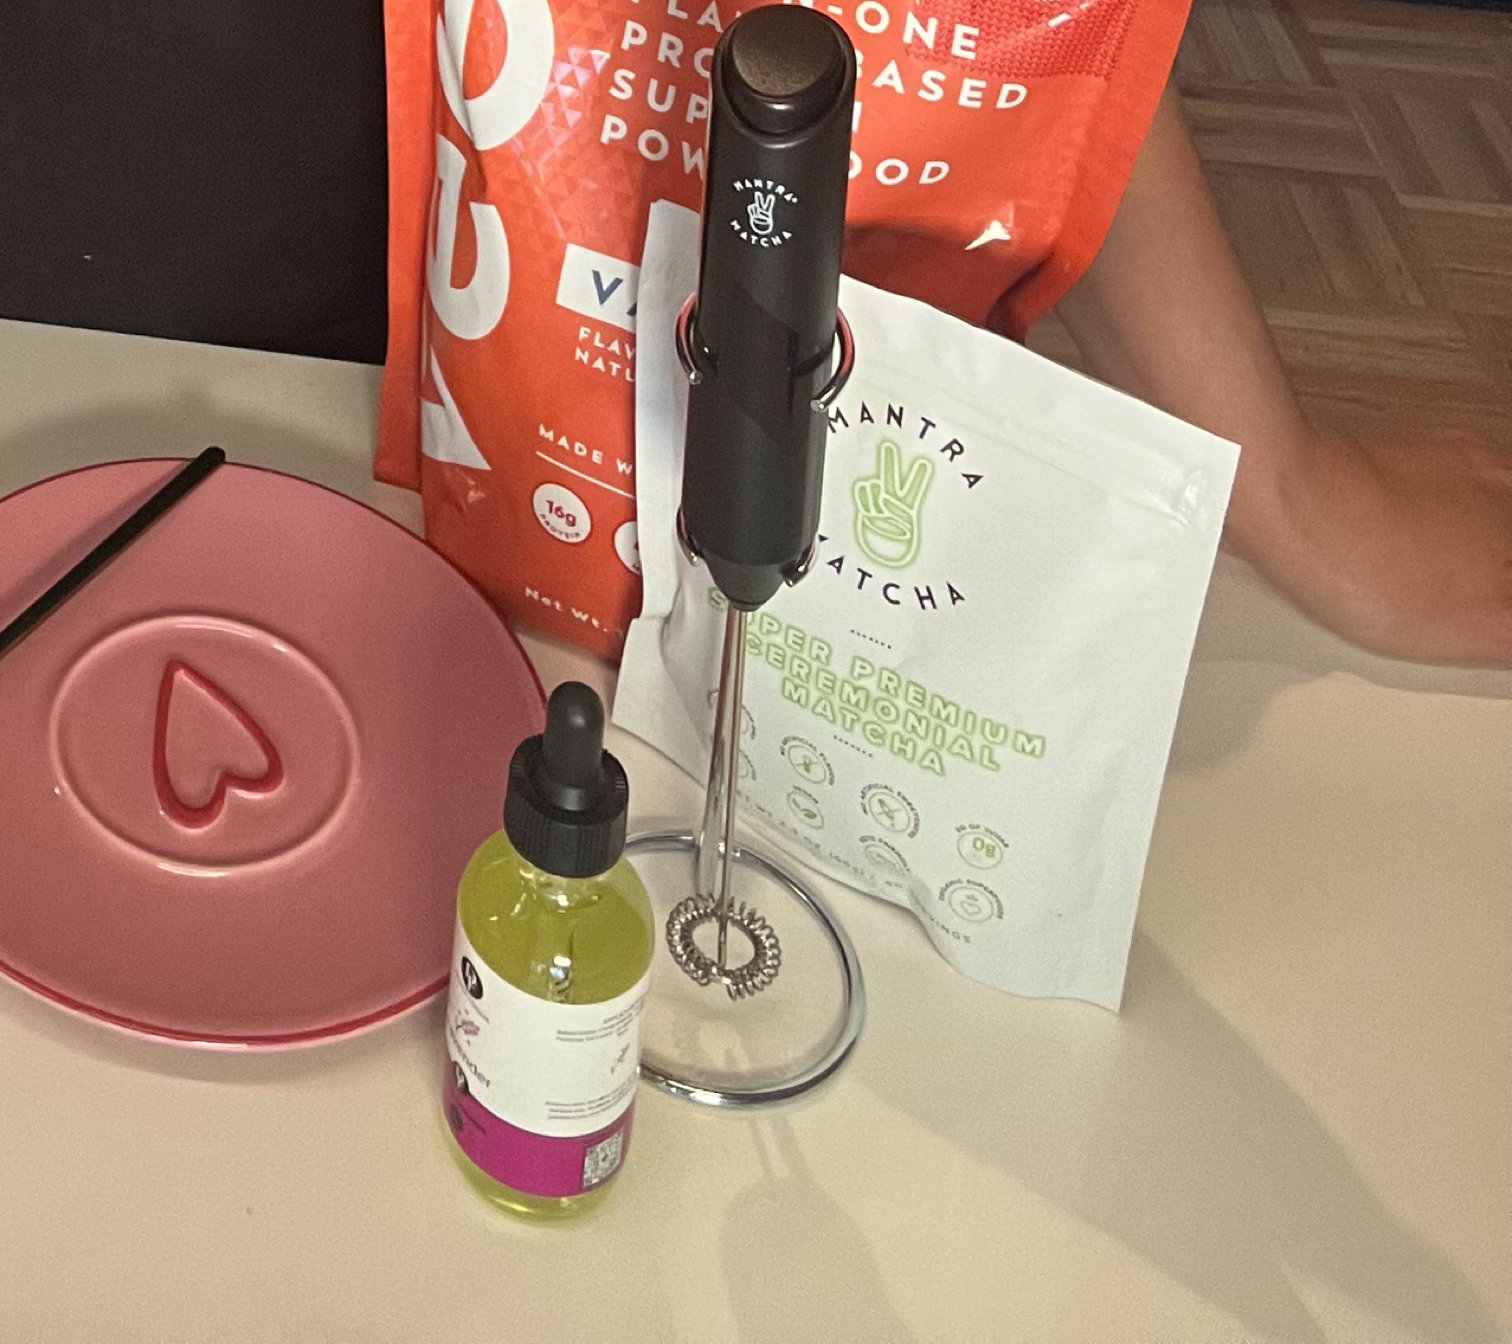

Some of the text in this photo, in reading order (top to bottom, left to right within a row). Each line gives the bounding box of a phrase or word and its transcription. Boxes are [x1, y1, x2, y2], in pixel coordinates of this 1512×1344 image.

[732, 178, 794, 202] MANTRA
[729, 219, 793, 248] MATCHA
[538, 423, 604, 465] MADE
[827, 400, 984, 490] MANTRA
[545, 499, 577, 528] 16g
[524, 587, 564, 613] Net
[817, 533, 965, 611] ATCHA
[708, 584, 1048, 761] SPER PREMIUM
[745, 632, 1002, 773] CEREMONIAL
[780, 677, 947, 778] MATCHA
